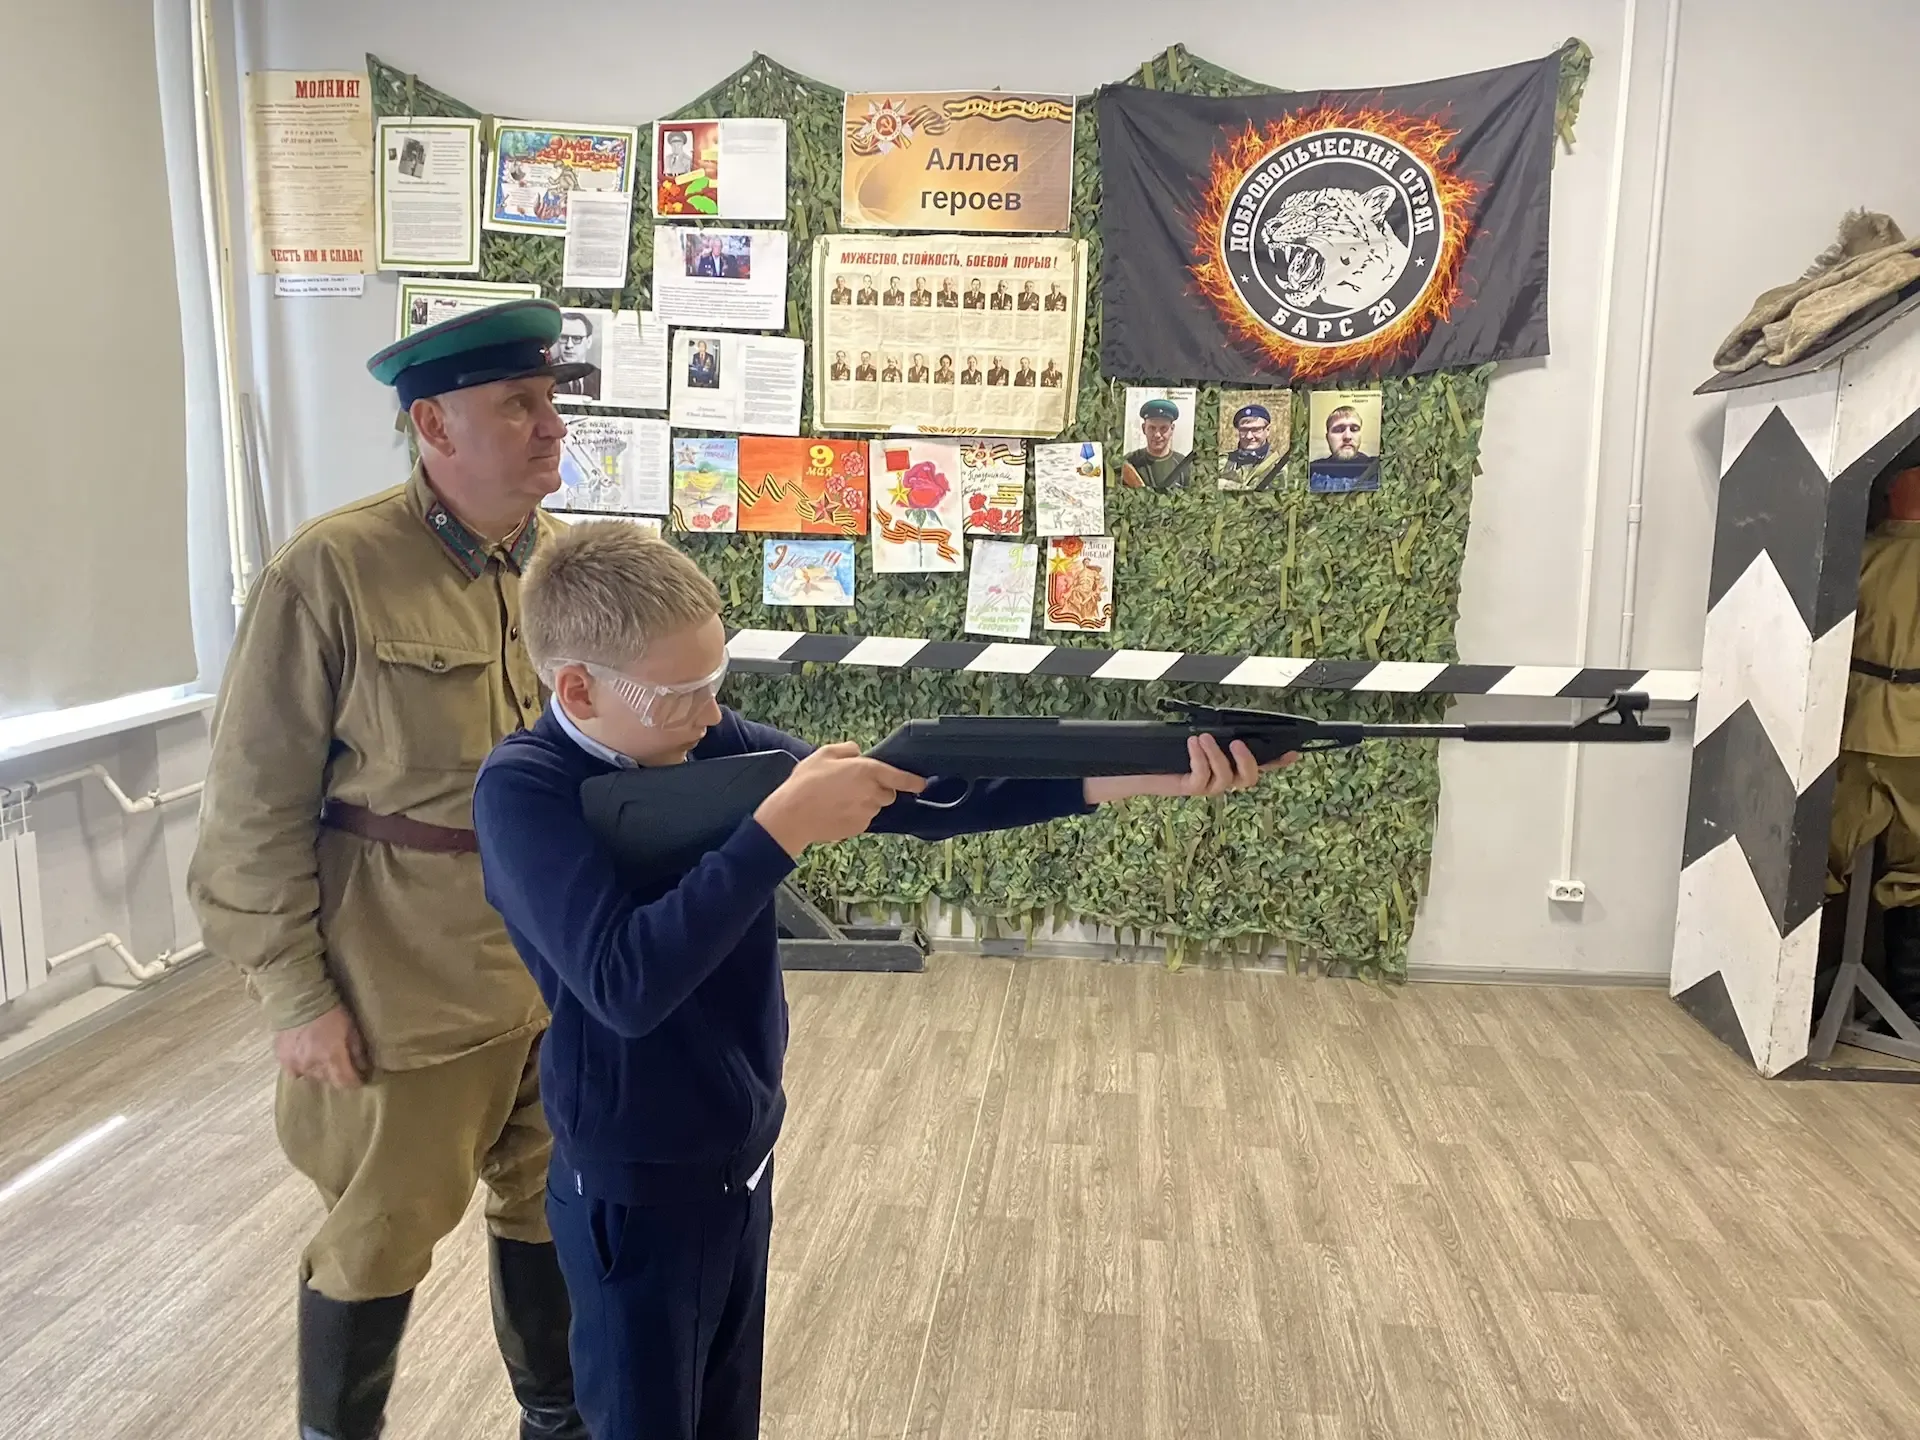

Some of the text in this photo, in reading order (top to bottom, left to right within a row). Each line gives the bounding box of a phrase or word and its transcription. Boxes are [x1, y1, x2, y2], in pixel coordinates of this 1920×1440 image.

[295, 79, 360, 98] МОЛНИЯ!
[964, 99, 1002, 117] 1941
[925, 148, 1019, 172] Аллея
[920, 190, 1022, 215] героев
[1230, 137, 1434, 253] ДОБРОВОЛЬЧЕСКИЙ ОТРЯД
[271, 249, 363, 263] ЧЕСТЬ ИМ И СЛАВА!
[840, 252, 900, 267] МУЖЕСТВО,
[902, 250, 963, 268] СТОЙКОСТЬ,
[966, 252, 1008, 268] БОЕВОЙ
[1271, 297, 1397, 339] БАРС 20
[809, 444, 835, 468] 9
[806, 466, 833, 476] мая
[768, 544, 788, 571] 9
